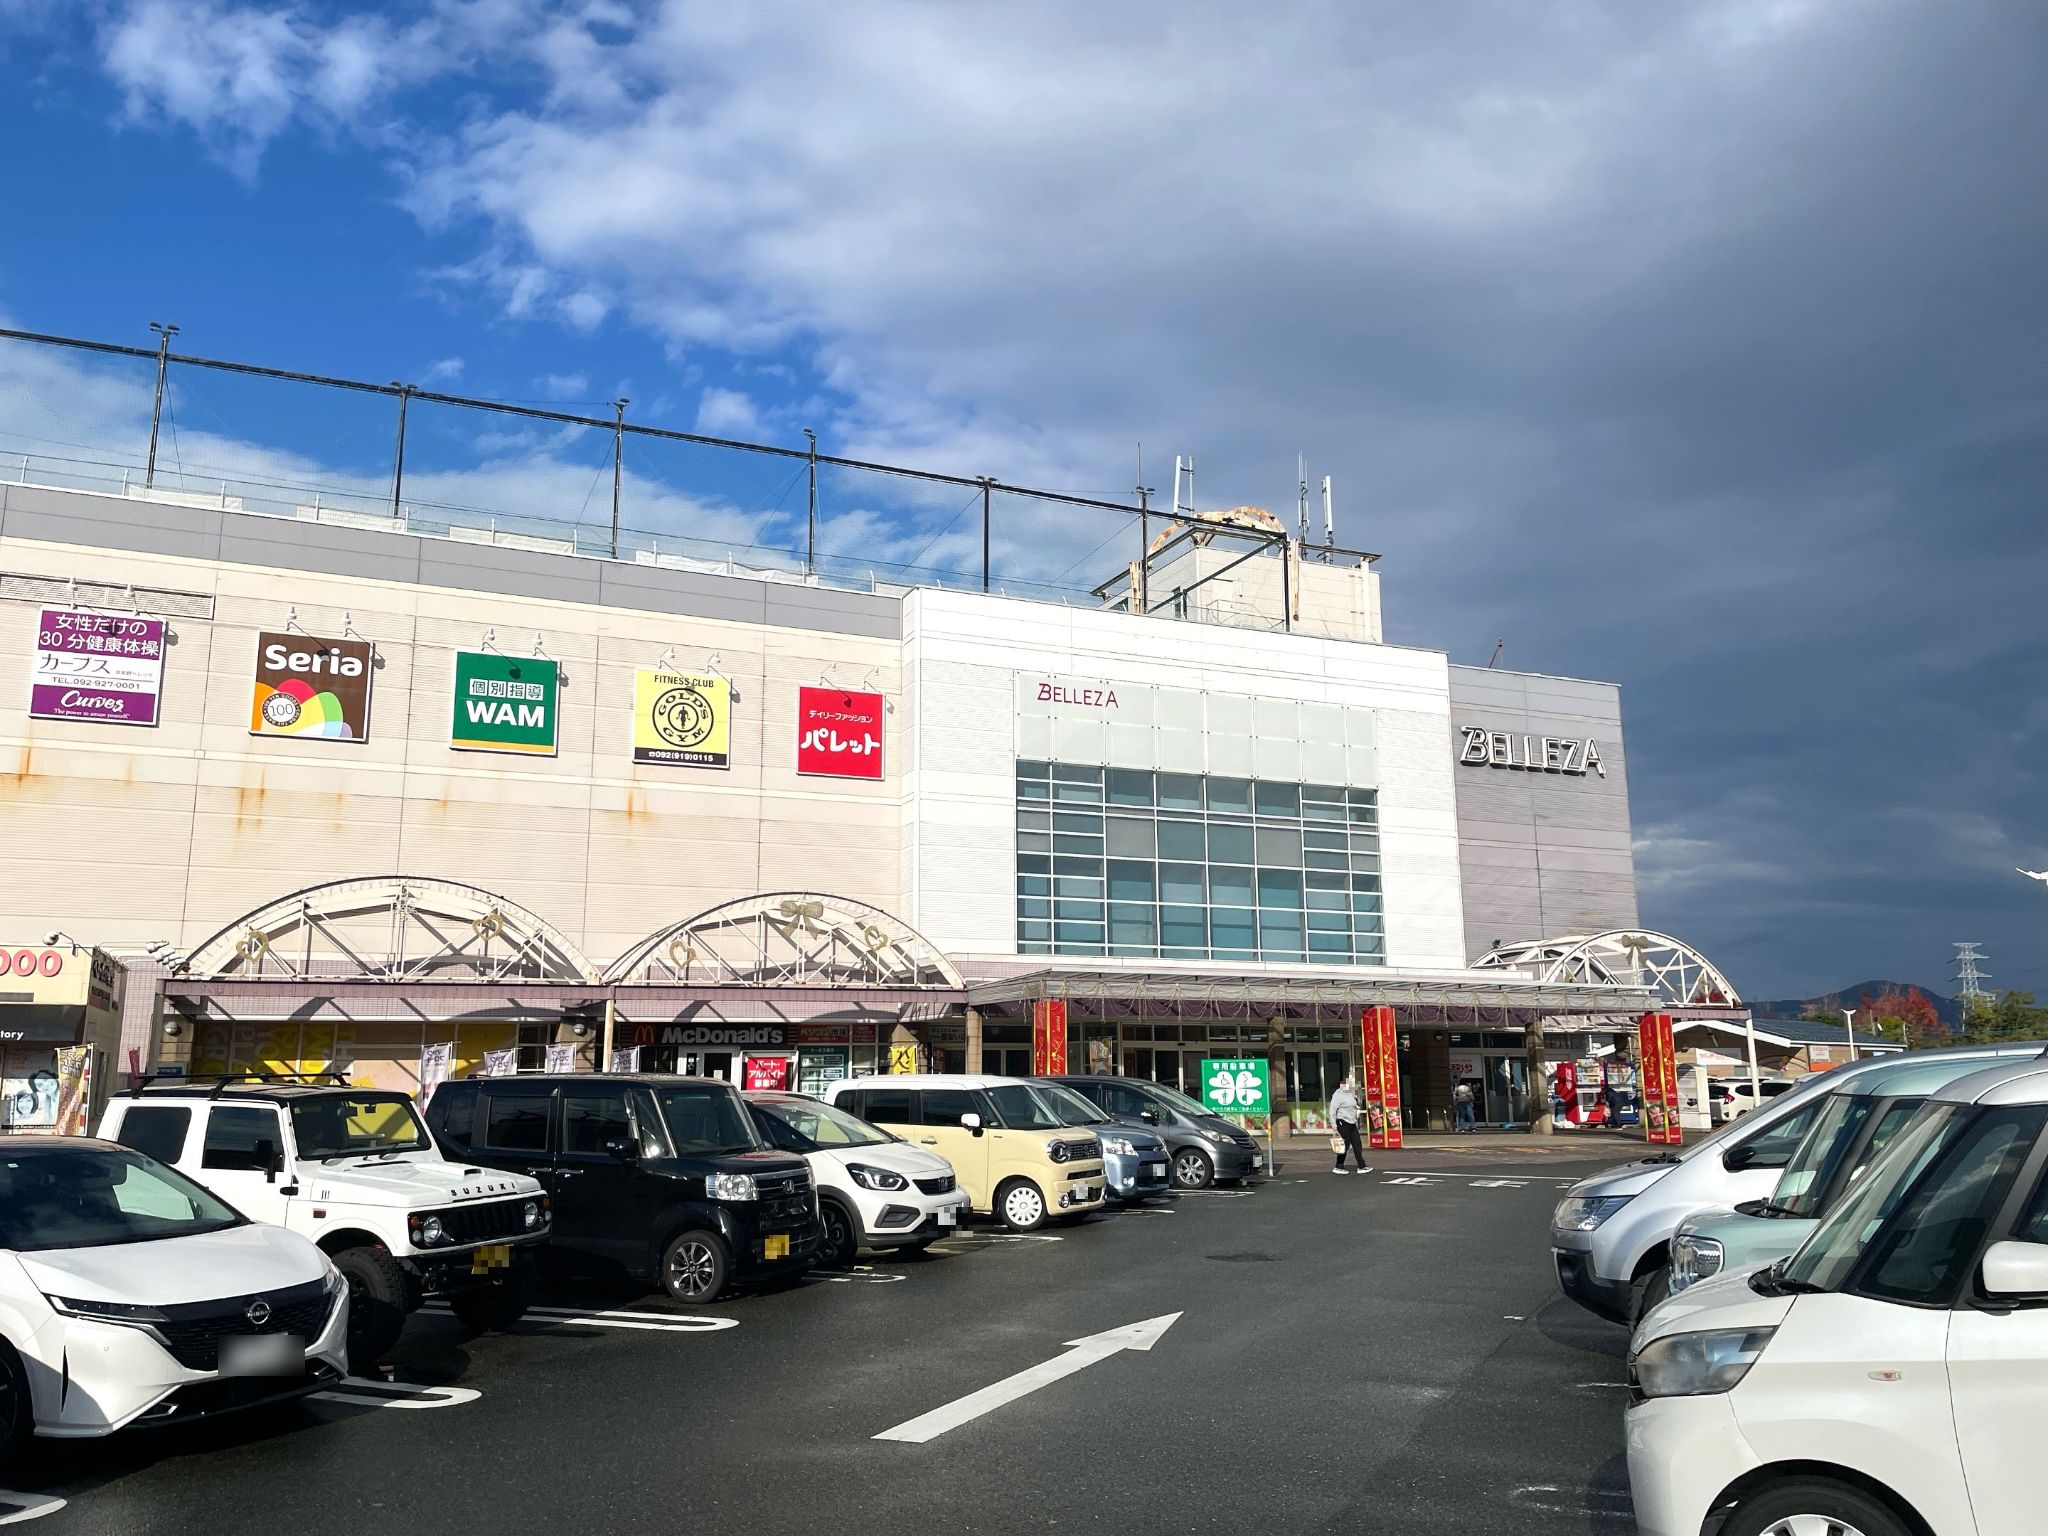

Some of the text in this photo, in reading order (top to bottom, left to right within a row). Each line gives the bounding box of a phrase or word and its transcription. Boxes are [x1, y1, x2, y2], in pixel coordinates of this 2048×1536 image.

[55, 613, 148, 636] 女性だけの
[40, 653, 110, 674] カーブス
[265, 644, 362, 676] Seria
[471, 680, 543, 699] 個別指導
[654, 675, 714, 688] FITNESS CLUB
[60, 690, 124, 712] Curves
[1037, 683, 1119, 708] BELLEZA
[270, 704, 294, 716] 100
[466, 700, 544, 728] WAM
[663, 727, 705, 742] GYM
[801, 728, 880, 755] パレット
[1460, 725, 1606, 778] BELLEZA
[662, 1027, 783, 1044] McDonald's
[451, 1182, 516, 1196] SUZUKI
